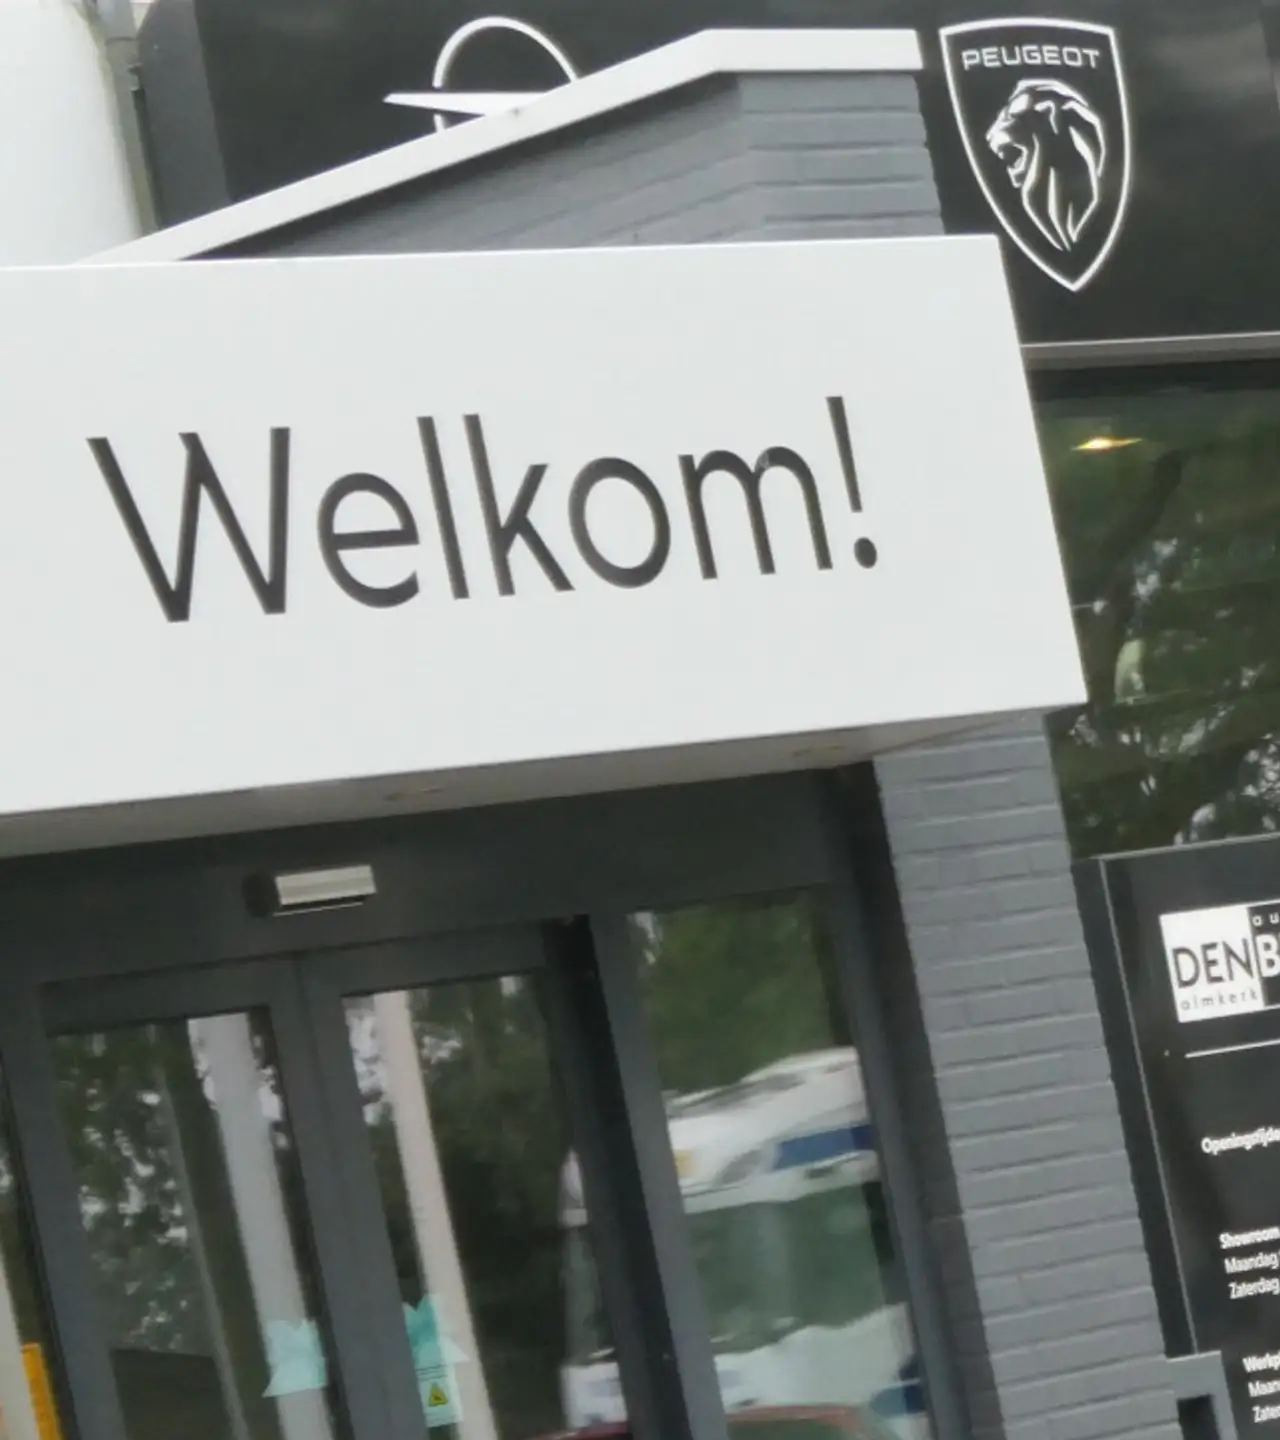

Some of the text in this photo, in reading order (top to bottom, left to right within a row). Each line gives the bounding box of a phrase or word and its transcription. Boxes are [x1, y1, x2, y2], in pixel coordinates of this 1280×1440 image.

[961, 44, 1101, 70] PEUGEOT
[86, 396, 879, 623] Welkom!
[1171, 937, 1256, 989] DEN
[1224, 1252, 1279, 1273] Maandag
[1228, 1277, 1280, 1299] Zaterdag
